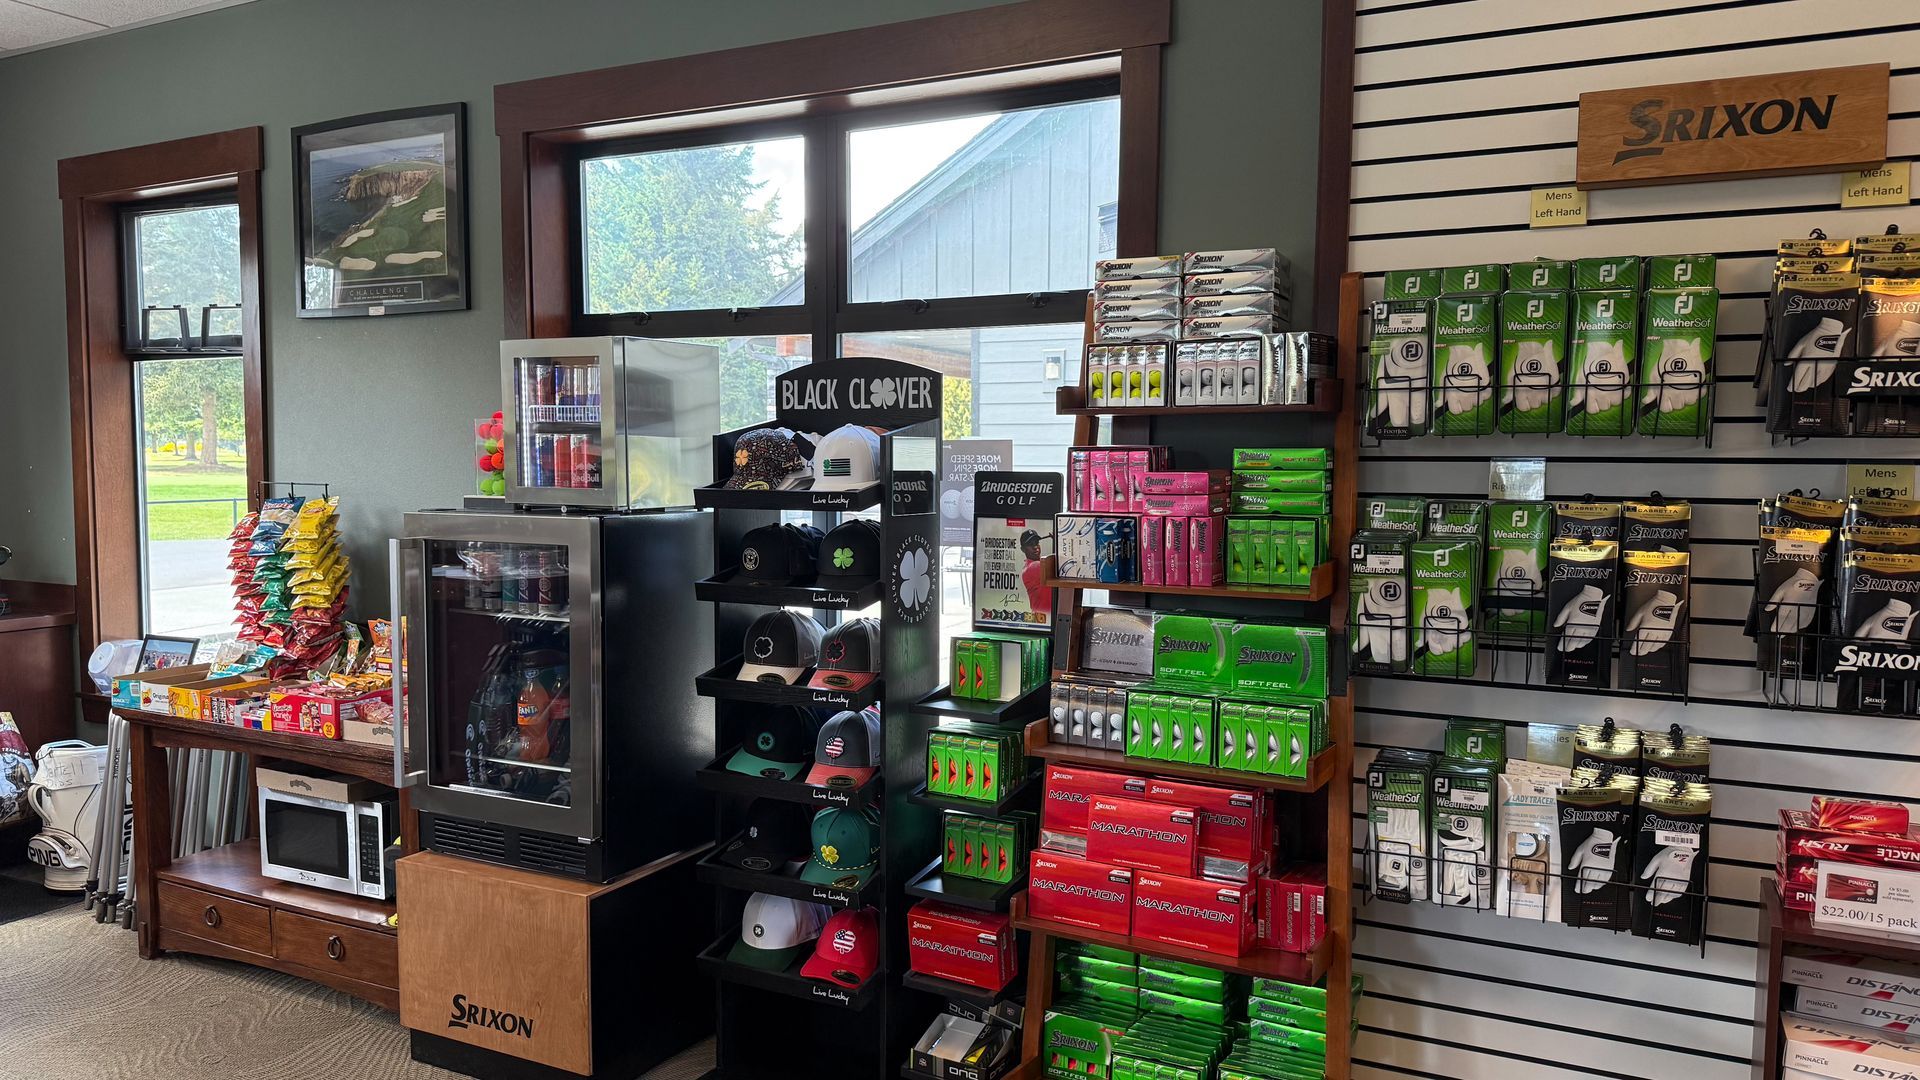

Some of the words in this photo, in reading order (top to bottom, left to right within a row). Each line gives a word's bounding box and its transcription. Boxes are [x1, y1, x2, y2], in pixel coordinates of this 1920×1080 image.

[1613, 94, 1838, 166] SRIXON
[1860, 167, 1893, 178] Mens
[1544, 190, 1573, 201] Mens
[1848, 187, 1874, 198] Left
[1876, 185, 1903, 196] Hand
[1534, 209, 1554, 218] Left
[1555, 207, 1582, 217] Hand
[1103, 262, 1133, 274] SRIXON
[1192, 254, 1225, 267] SRIXON
[1532, 268, 1549, 287] FJ
[1599, 263, 1617, 283] FJ
[1673, 263, 1693, 282] FJ
[1192, 277, 1225, 290] SRIXON
[1404, 276, 1421, 294] FJ
[1463, 271, 1480, 290] FJ
[349, 286, 409, 297] CHALLENGE
[1191, 299, 1224, 312] SRIXON
[1373, 303, 1388, 320] FJ
[1456, 303, 1474, 322] FJ
[1526, 299, 1545, 318] FJ
[1596, 299, 1615, 318] FJ
[1673, 295, 1694, 315] FJ
[1784, 295, 1853, 317] SRIXON
[1863, 299, 1920, 319] SRIXO
[1191, 321, 1223, 334] SRIXON
[1438, 324, 1492, 336] WeatherSof
[1507, 320, 1562, 332] WeatherSof
[1576, 320, 1633, 331] WeatherSof
[1652, 317, 1712, 328] WeatherSof
[1101, 325, 1132, 337] SRIXON
[1847, 366, 1920, 395] SRIXO
[782, 379, 839, 410] BLACK
[1865, 468, 1897, 478] Mens
[980, 481, 1053, 494] BRIDGESTONE
[812, 494, 827, 505] Live
[827, 494, 850, 508] Lucky
[996, 496, 1037, 505] GOLF
[1790, 500, 1832, 510] CABRETTA
[1864, 499, 1909, 508] CABRETTA
[1428, 503, 1443, 518] FJ
[1370, 520, 1417, 530] WeatherSof
[1511, 510, 1528, 528] FJ
[1429, 523, 1479, 534] WeatherSof
[1493, 529, 1545, 540] WeatherSof
[1627, 524, 1687, 542] SRIXON
[993, 550, 1005, 561] BEST
[1351, 544, 1365, 560] FJ
[1433, 549, 1450, 567] FJ
[1866, 556, 1914, 564] CABRETTA
[1415, 569, 1467, 579] WeatherSof
[1551, 563, 1612, 583] SRIXON
[1626, 569, 1686, 586] SRIXON
[1851, 573, 1920, 594] SRIXON
[812, 592, 827, 603] Live
[827, 592, 850, 607] Lucky
[1089, 627, 1145, 647] SRIXON
[1157, 634, 1212, 655] SRIXON
[1236, 645, 1297, 666] SRIXON
[1159, 666, 1183, 674] SOFT
[1184, 668, 1208, 676] FEEL
[1238, 679, 1265, 687] SOFT
[1266, 681, 1292, 689] FEEL
[812, 692, 827, 702] Live
[828, 693, 850, 707] Lucky
[1466, 736, 1482, 754] FJ
[1052, 771, 1073, 780] SRIXON
[1369, 772, 1383, 787] FJ
[1150, 785, 1175, 795] SRIXON
[1434, 777, 1449, 793] FJ
[812, 789, 827, 800] Live
[828, 790, 849, 806] Lucky
[1049, 789, 1091, 804] MARA
[1371, 790, 1420, 804] WeatherSof
[1094, 801, 1118, 811] SRIXON
[1199, 811, 1247, 828] THON
[1561, 807, 1618, 825] SRIXON
[1641, 814, 1703, 834] SRIXON
[1090, 820, 1188, 844] MARATHON
[1798, 839, 1850, 852] RUSH
[29, 845, 62, 867] PING
[1877, 847, 1920, 861] NACLE
[1035, 858, 1058, 869] SRIXON
[1138, 876, 1162, 887] SRIXON
[812, 888, 827, 899] Live
[828, 890, 850, 906] Lucky
[1032, 877, 1125, 903] MARATHON
[1136, 896, 1235, 923] MARATHON
[1822, 905, 1884, 924] $22.00/15
[1887, 917, 1919, 930] pack
[911, 936, 995, 964] MARATHON
[1791, 969, 1824, 979] PINNACLE
[812, 985, 827, 998] Live
[828, 988, 850, 1005] Lucky
[1806, 999, 1838, 1009] PINNACLE
[448, 993, 534, 1039] SRIXON
[1260, 1012, 1280, 1020] SOFT
[1281, 1015, 1300, 1024] FEEL
[1049, 1029, 1099, 1051] SRIXON
[1262, 1035, 1281, 1044] SOFT
[1793, 1025, 1920, 1053] DISTANC
[1795, 1054, 1829, 1065] PINNACLE
[1048, 1067, 1069, 1077] SOFT
